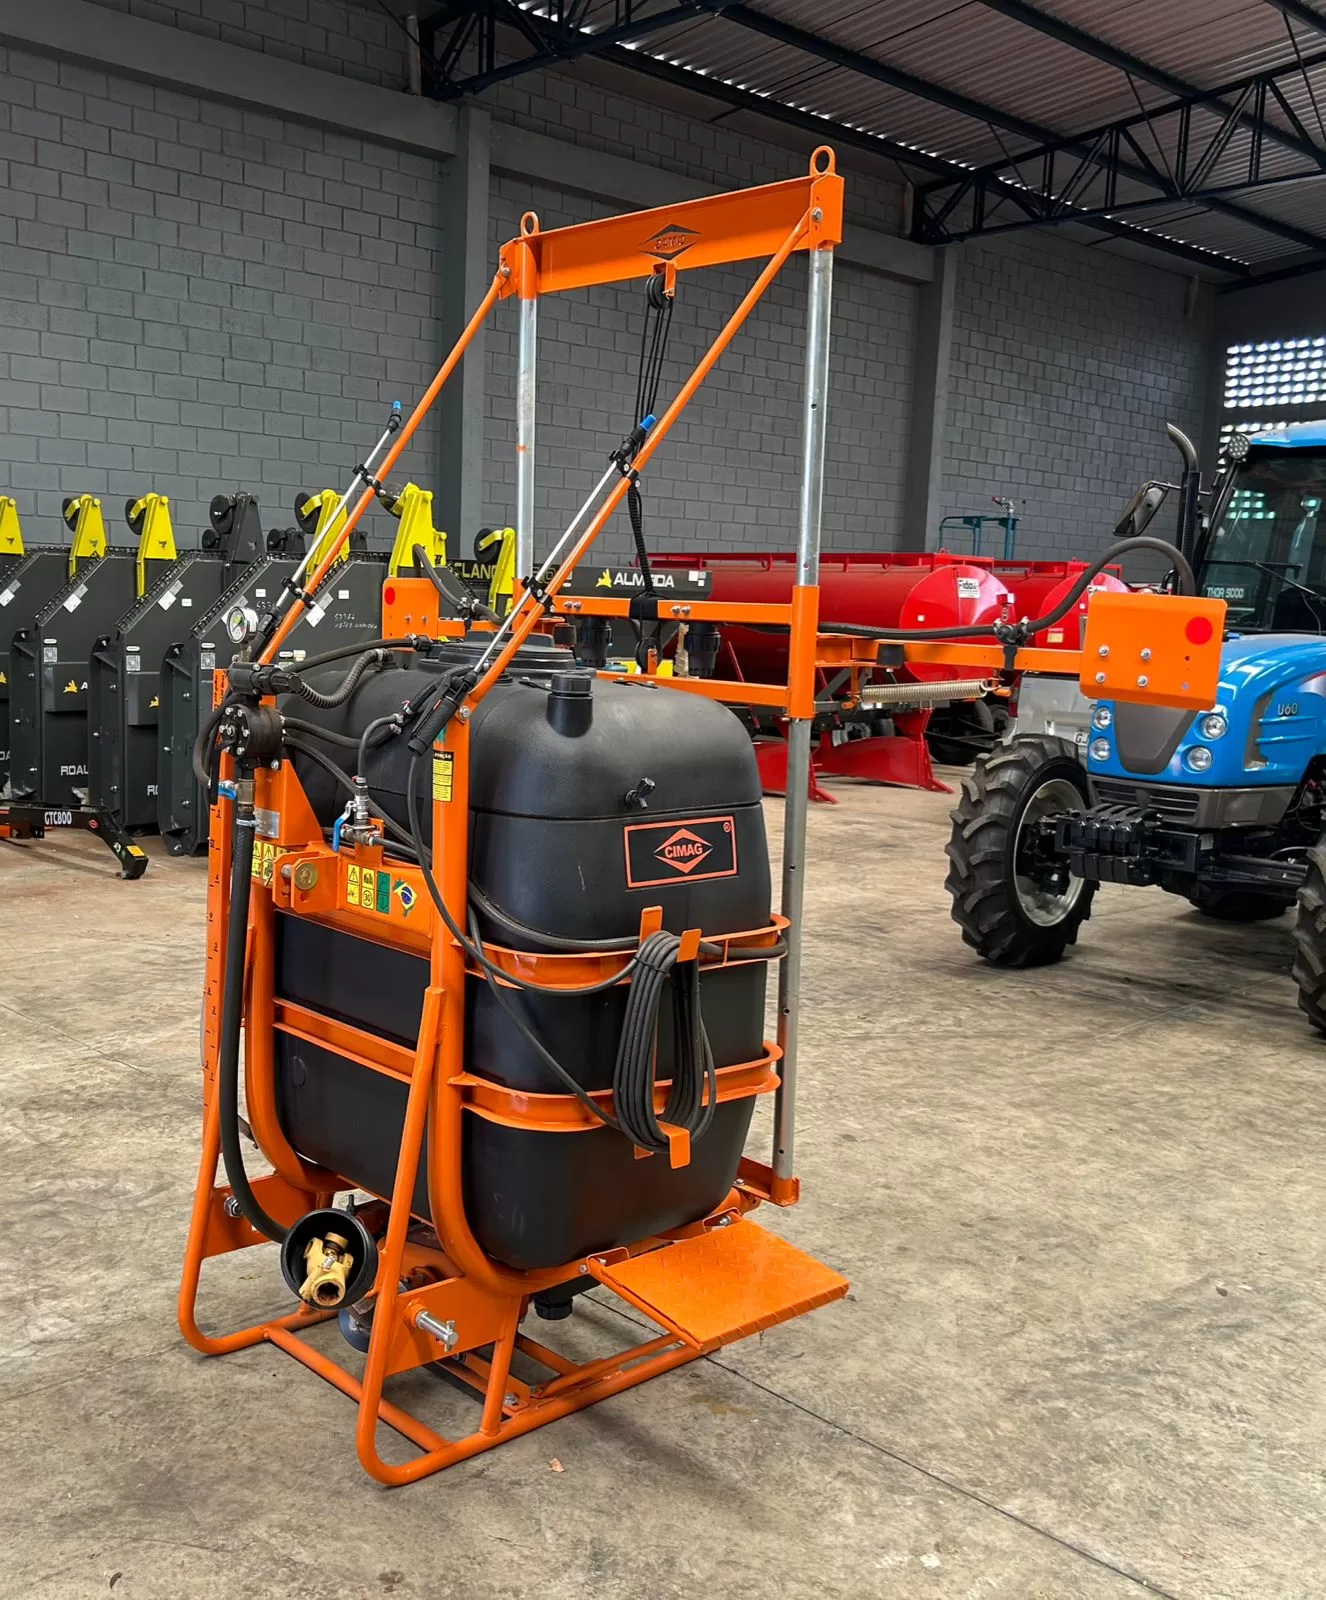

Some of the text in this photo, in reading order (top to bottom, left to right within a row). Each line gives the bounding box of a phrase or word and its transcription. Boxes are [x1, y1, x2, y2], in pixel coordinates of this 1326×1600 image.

[613, 571, 675, 588] ALMIDA
[1277, 702, 1297, 716] U60
[44, 811, 72, 825] GTC800
[664, 843, 703, 858] CIMAG
